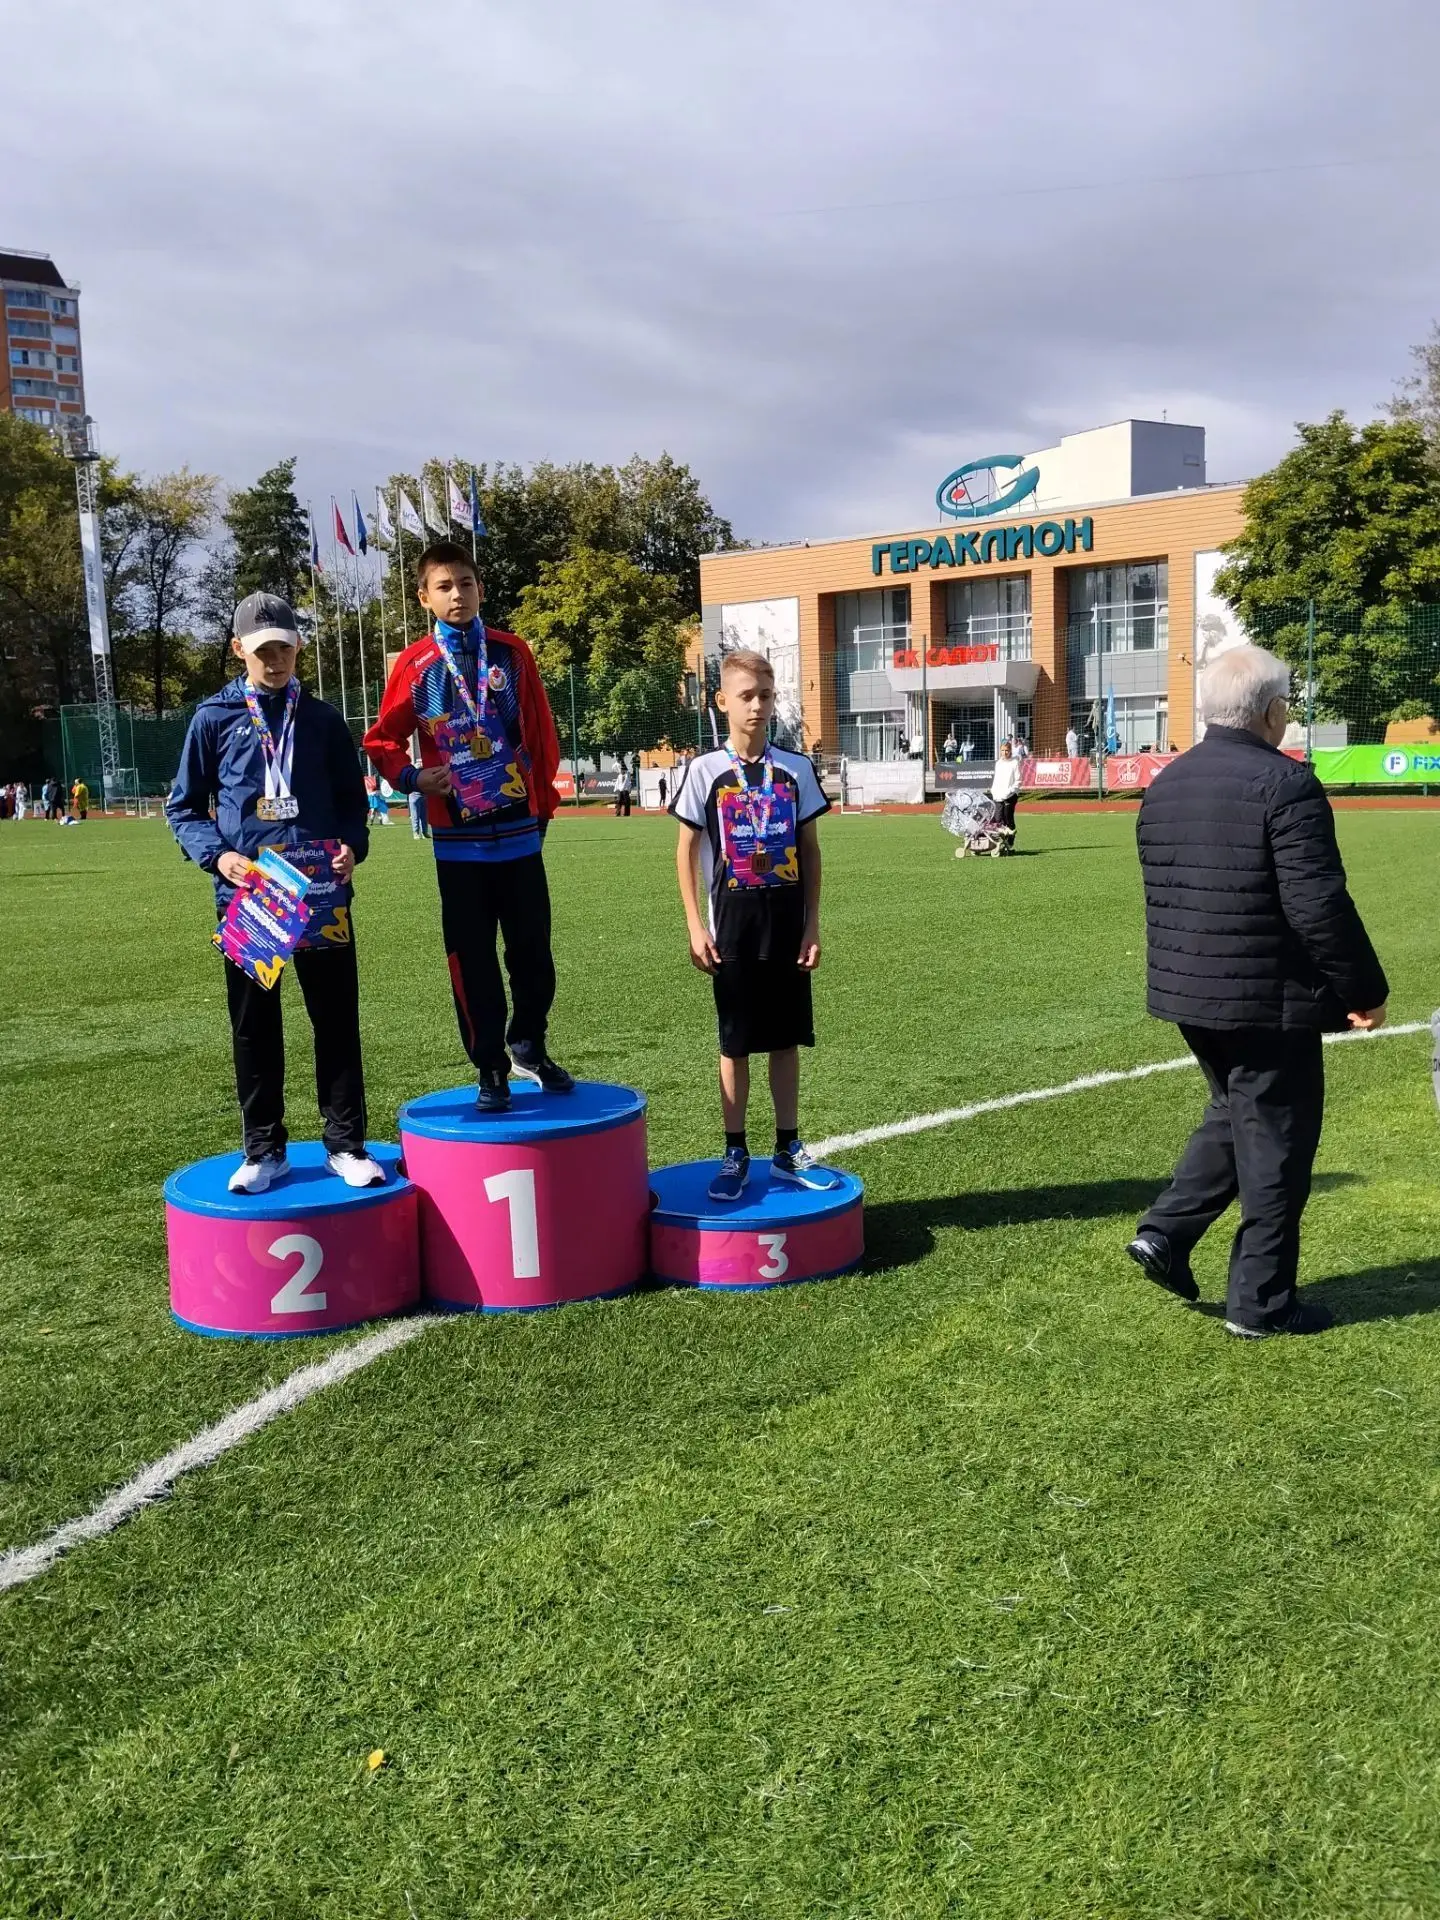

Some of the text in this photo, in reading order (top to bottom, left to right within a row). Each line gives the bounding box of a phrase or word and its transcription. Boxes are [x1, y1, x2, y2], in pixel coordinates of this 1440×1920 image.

[871, 516, 1093, 576] ГЕРАКЛИОН
[893, 649, 920, 668] СК
[1037, 773, 1069, 783] BRANDS
[1058, 764, 1070, 773] 43
[483, 1168, 540, 1279] 1
[266, 1234, 327, 1315] 2
[757, 1233, 789, 1279] 3
